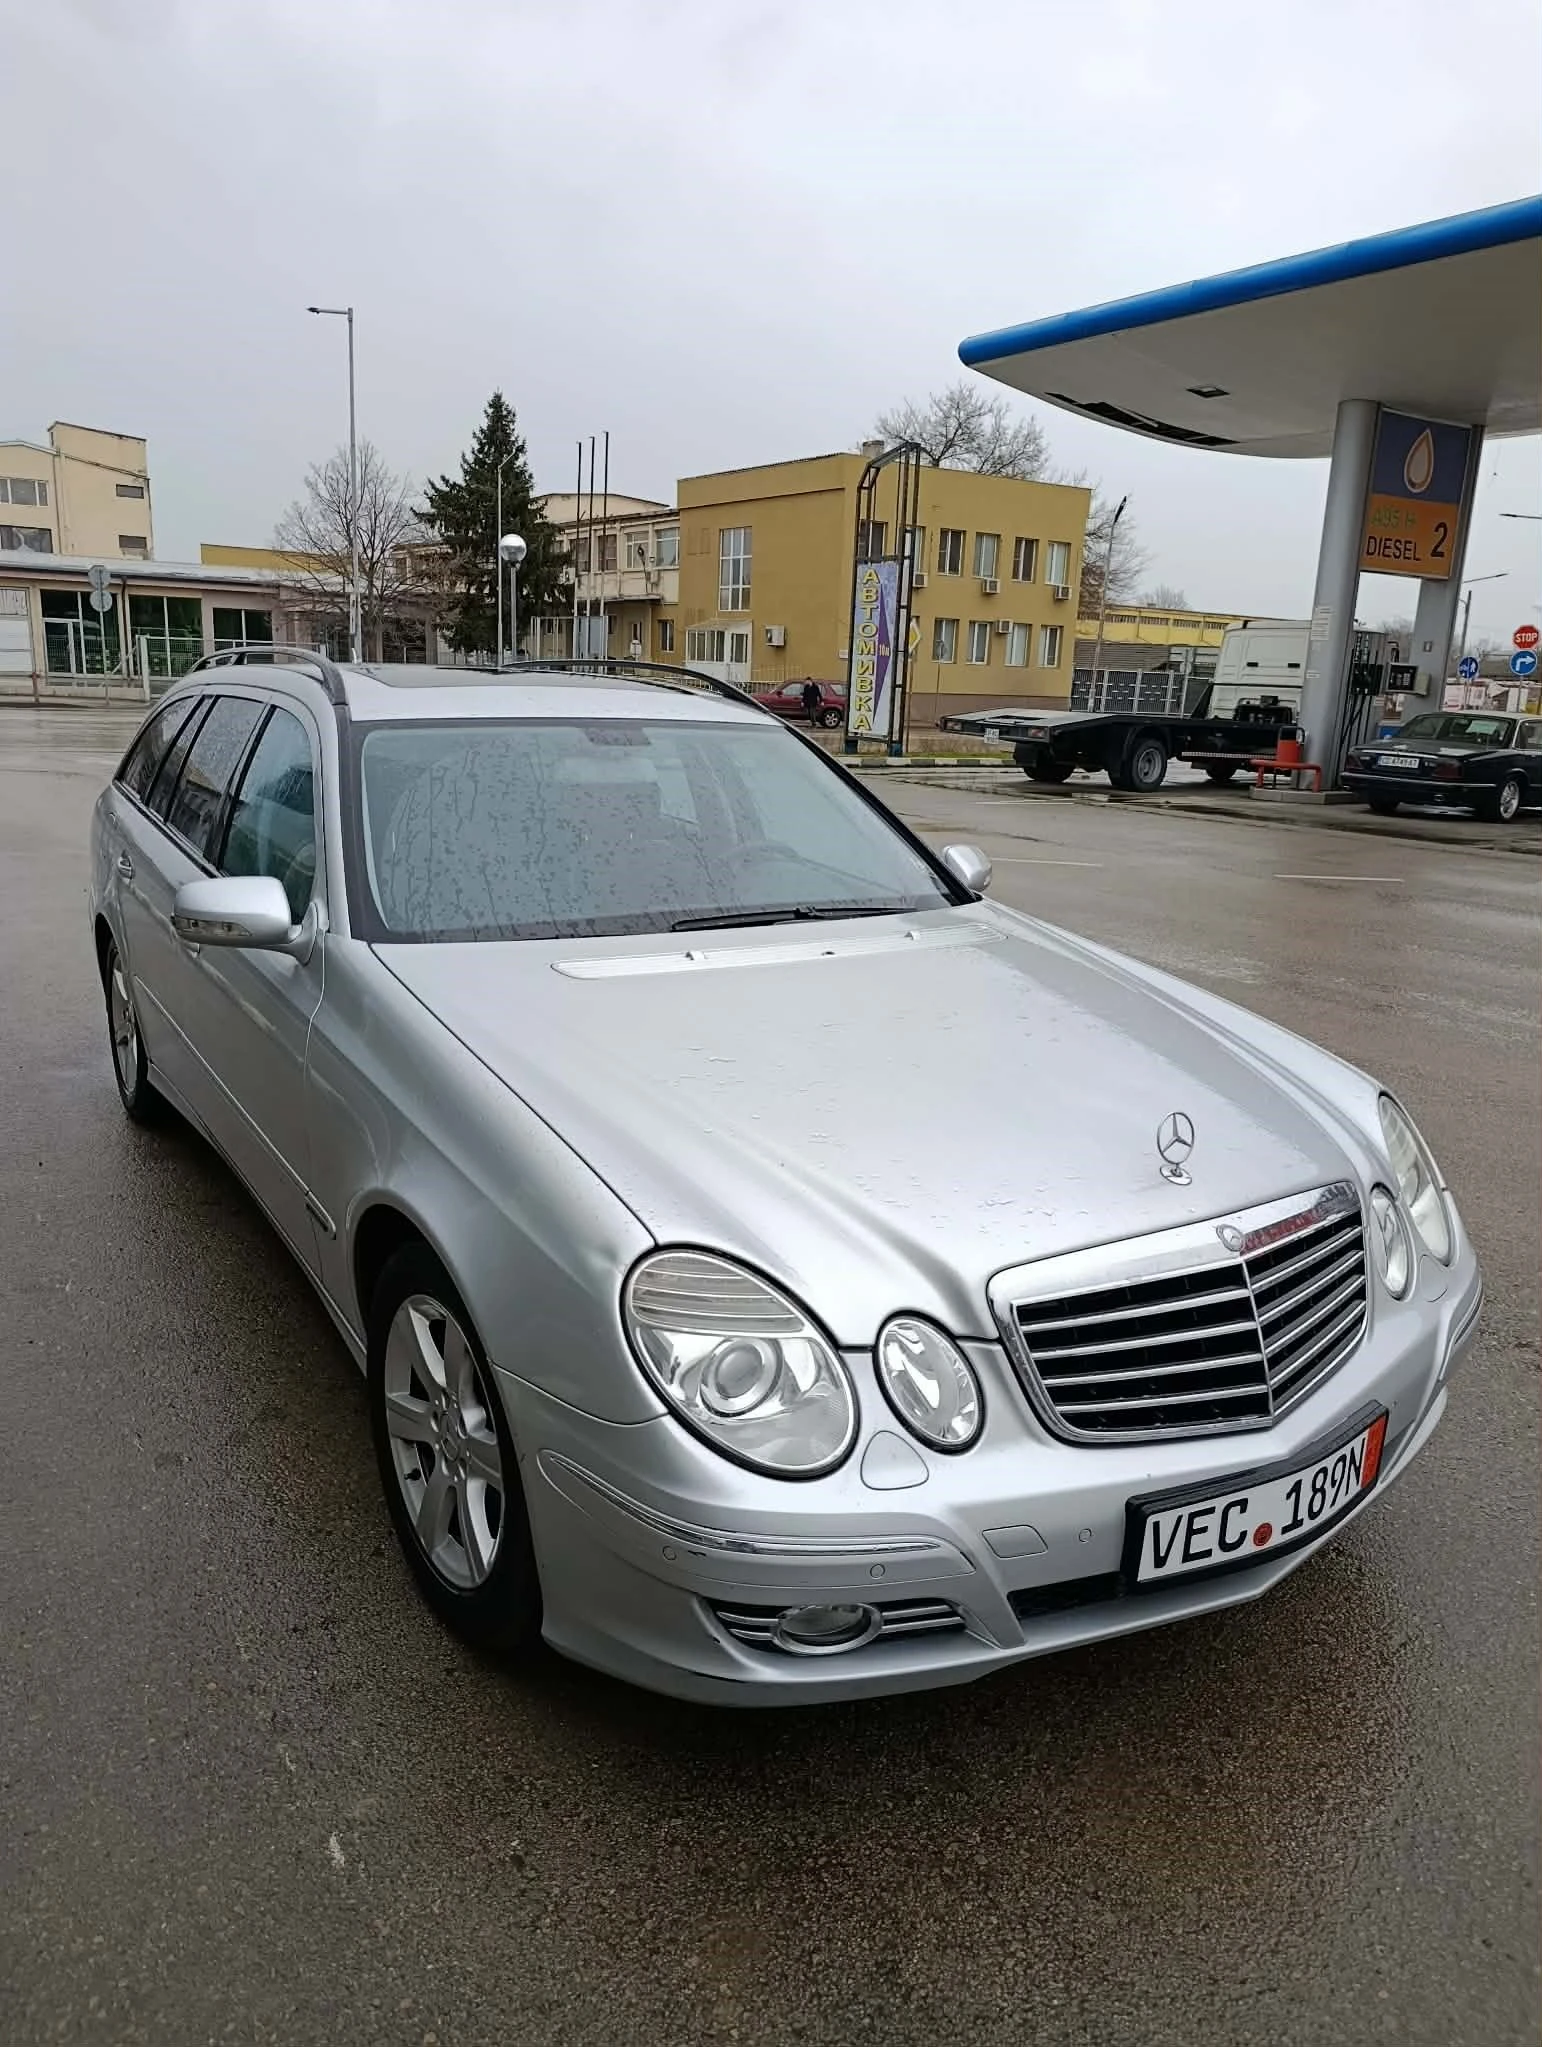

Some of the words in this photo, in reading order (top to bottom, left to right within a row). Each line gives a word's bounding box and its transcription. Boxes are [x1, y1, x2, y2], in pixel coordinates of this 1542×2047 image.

[1366, 535, 1422, 561] DIESEL
[1430, 521, 1448, 558] 2
[853, 568, 881, 731] АВТОМИВКА
[1515, 632, 1537, 643] STOP
[1152, 1497, 1249, 1569] VEC
[1281, 1437, 1366, 1536] 189N
